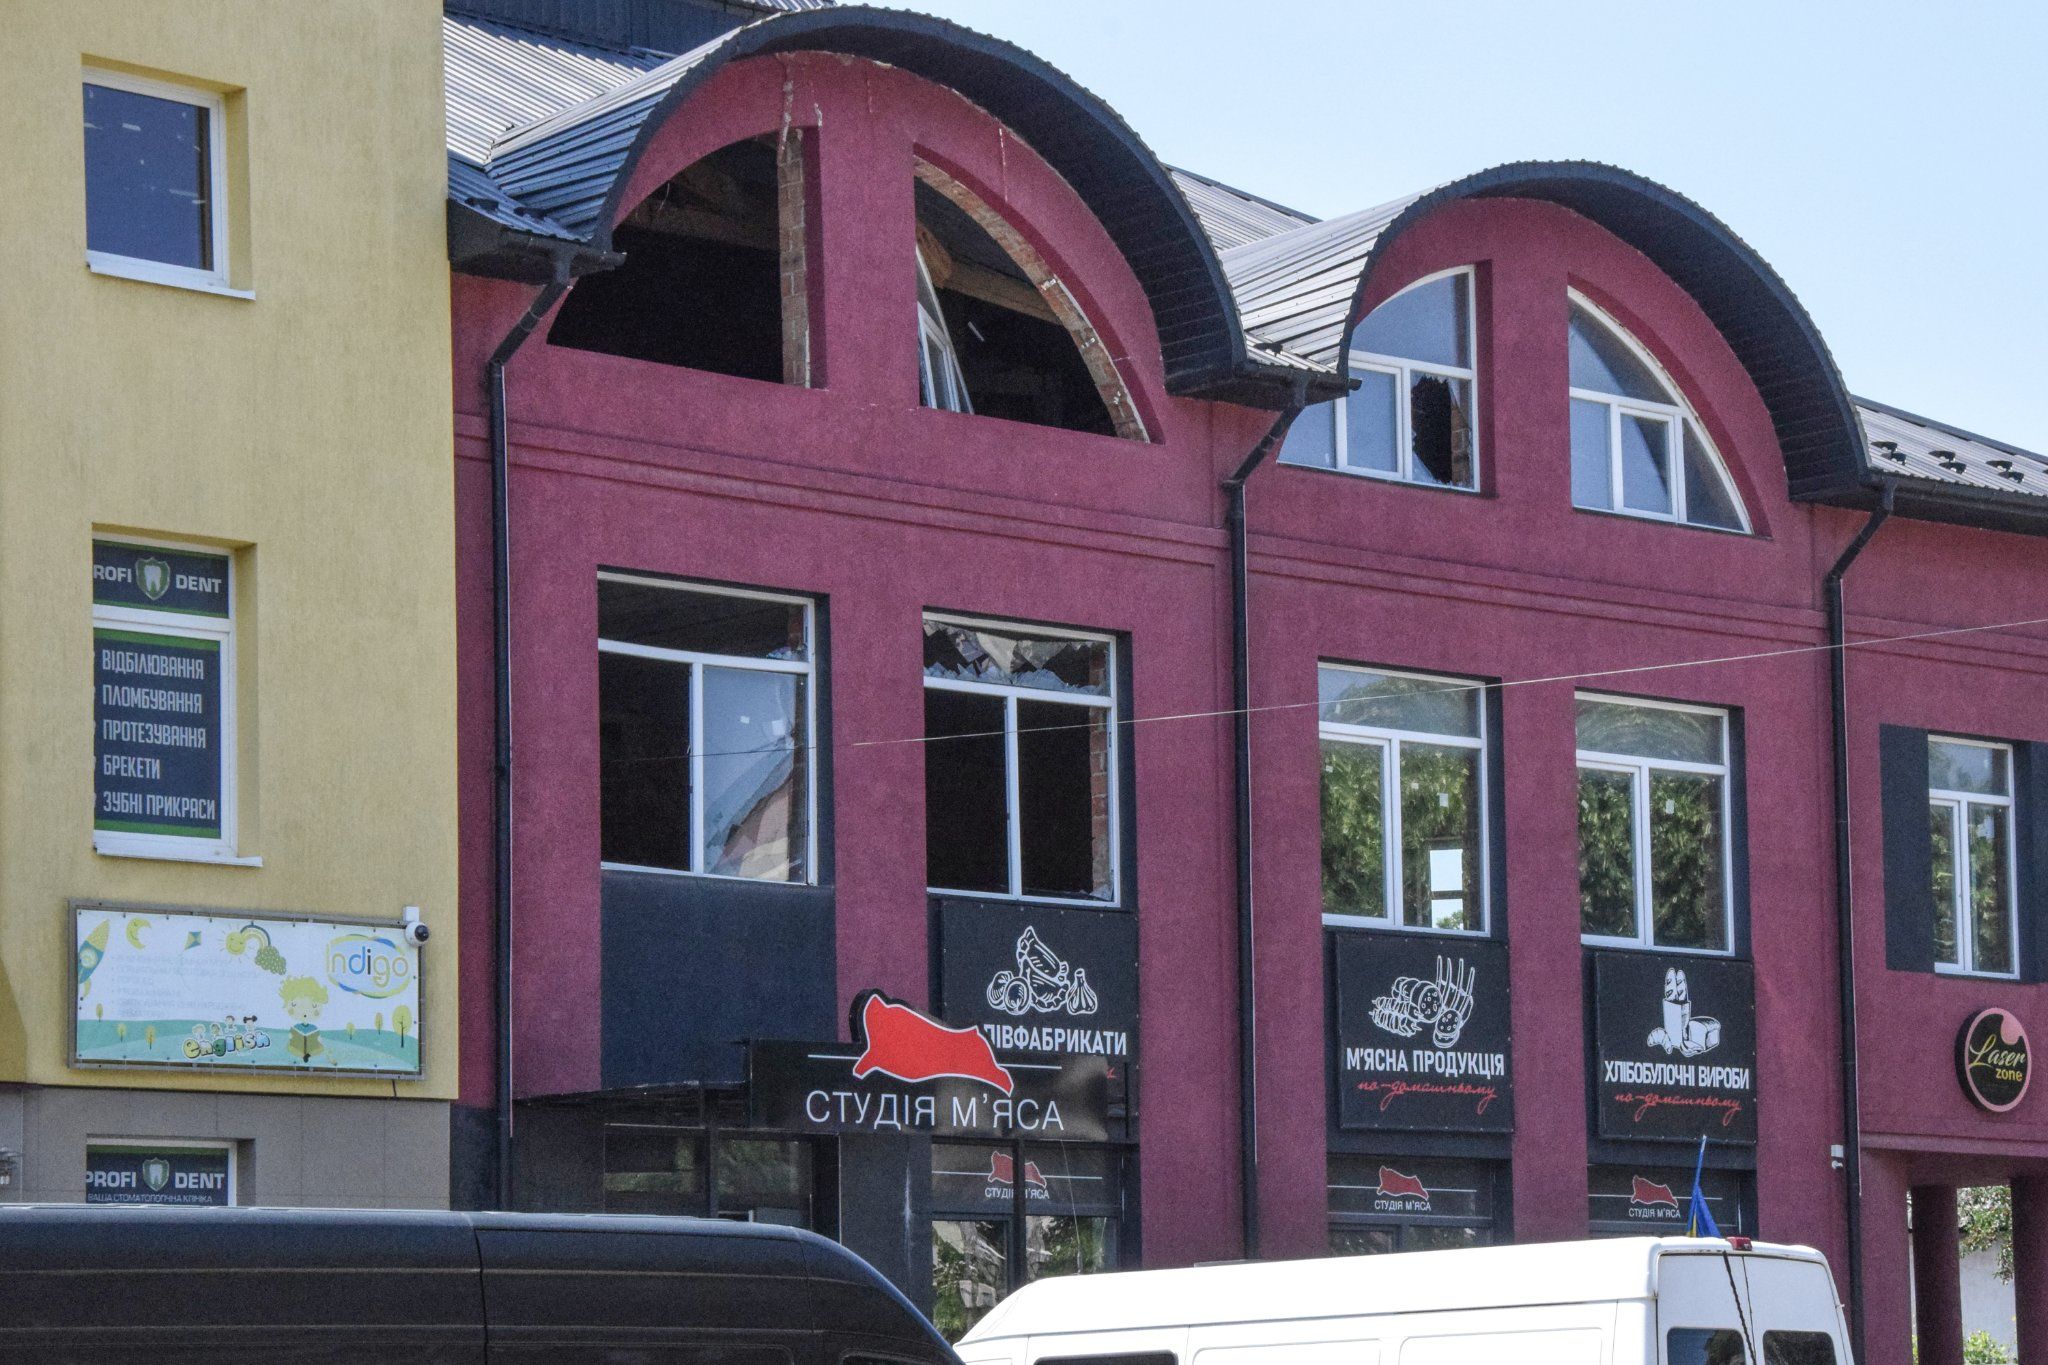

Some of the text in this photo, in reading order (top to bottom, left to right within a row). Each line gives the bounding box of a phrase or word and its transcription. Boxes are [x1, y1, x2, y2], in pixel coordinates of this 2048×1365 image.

[93, 564, 222, 594] ROFI DENT
[102, 649, 204, 680] ВІДБІЛЮВАННЯ
[102, 684, 203, 714] ПЛОМБУВАННЯ
[103, 719, 206, 749] ПРОТЕЗУВАННЯ
[103, 755, 161, 780] БРЕКЕТИ
[103, 790, 216, 821] ЗУБНІ ПРИКРАСИ
[326, 943, 409, 988] Indigo
[983, 1023, 1127, 1056] ПІВФАБРИКАТИ
[1969, 1033, 2026, 1070] Laser
[1346, 1047, 1505, 1080] М'ЯСНА ПРОДУКЦІЯ
[1604, 1060, 1750, 1090] ХЛІБОБУЛОЧНІ ВИРОБИ
[1995, 1068, 2023, 1082] zone
[806, 1089, 1065, 1131] СТУДІЯ М'ЯСА
[1357, 1079, 1498, 1115] по-домашньому
[1614, 1092, 1743, 1127] по-домашньому
[86, 1170, 225, 1189] PROFI DENT
[1374, 1199, 1432, 1212] СТУДІЯ М'ЯСА
[1628, 1207, 1656, 1219] СТУДІЯ
